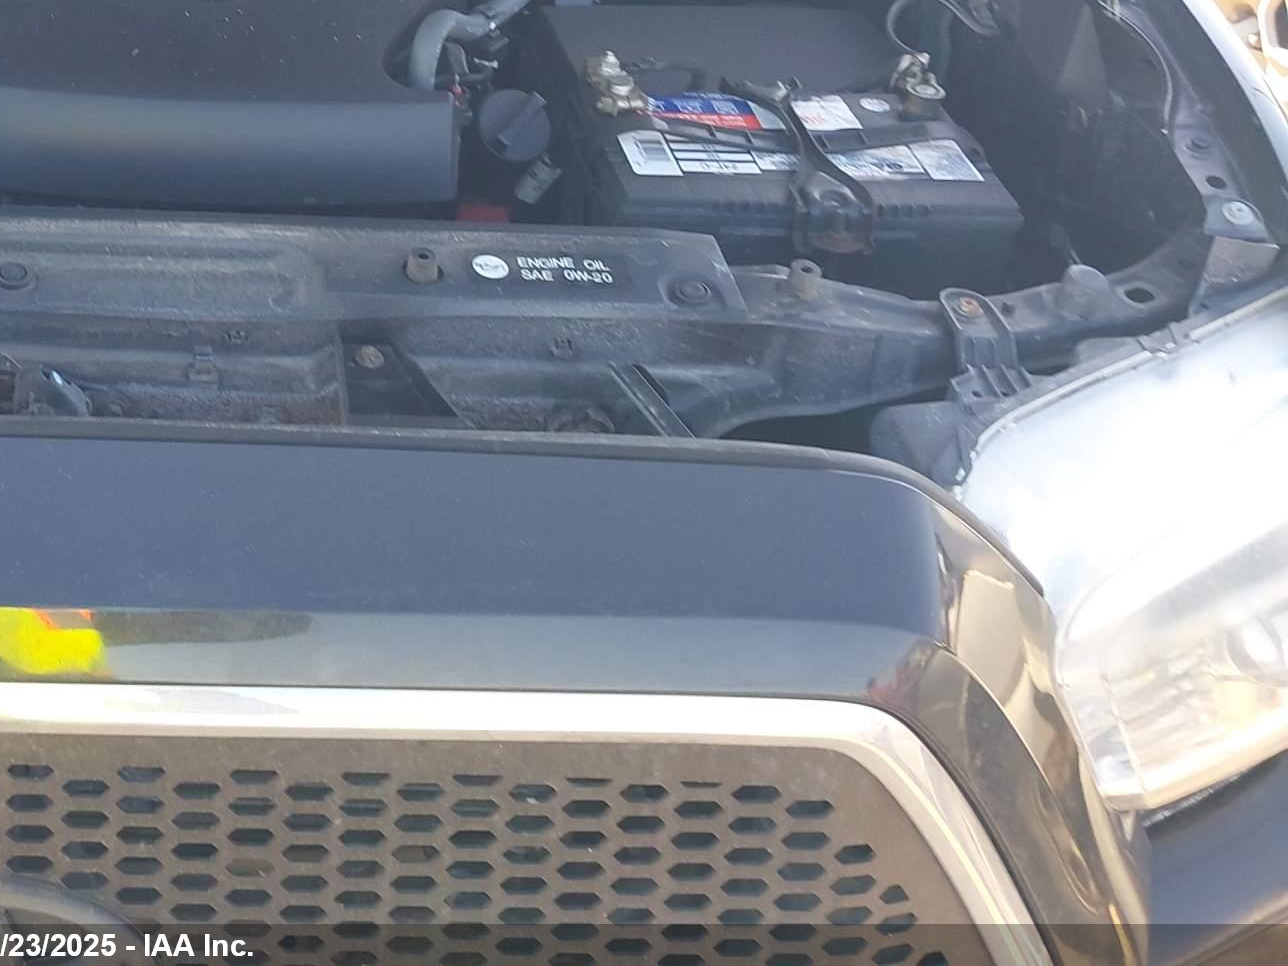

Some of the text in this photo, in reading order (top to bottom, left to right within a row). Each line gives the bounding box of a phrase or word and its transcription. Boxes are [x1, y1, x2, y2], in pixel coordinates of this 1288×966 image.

[516, 256, 612, 271] ENGINE OIL
[521, 269, 613, 283] SAE 0W-20
